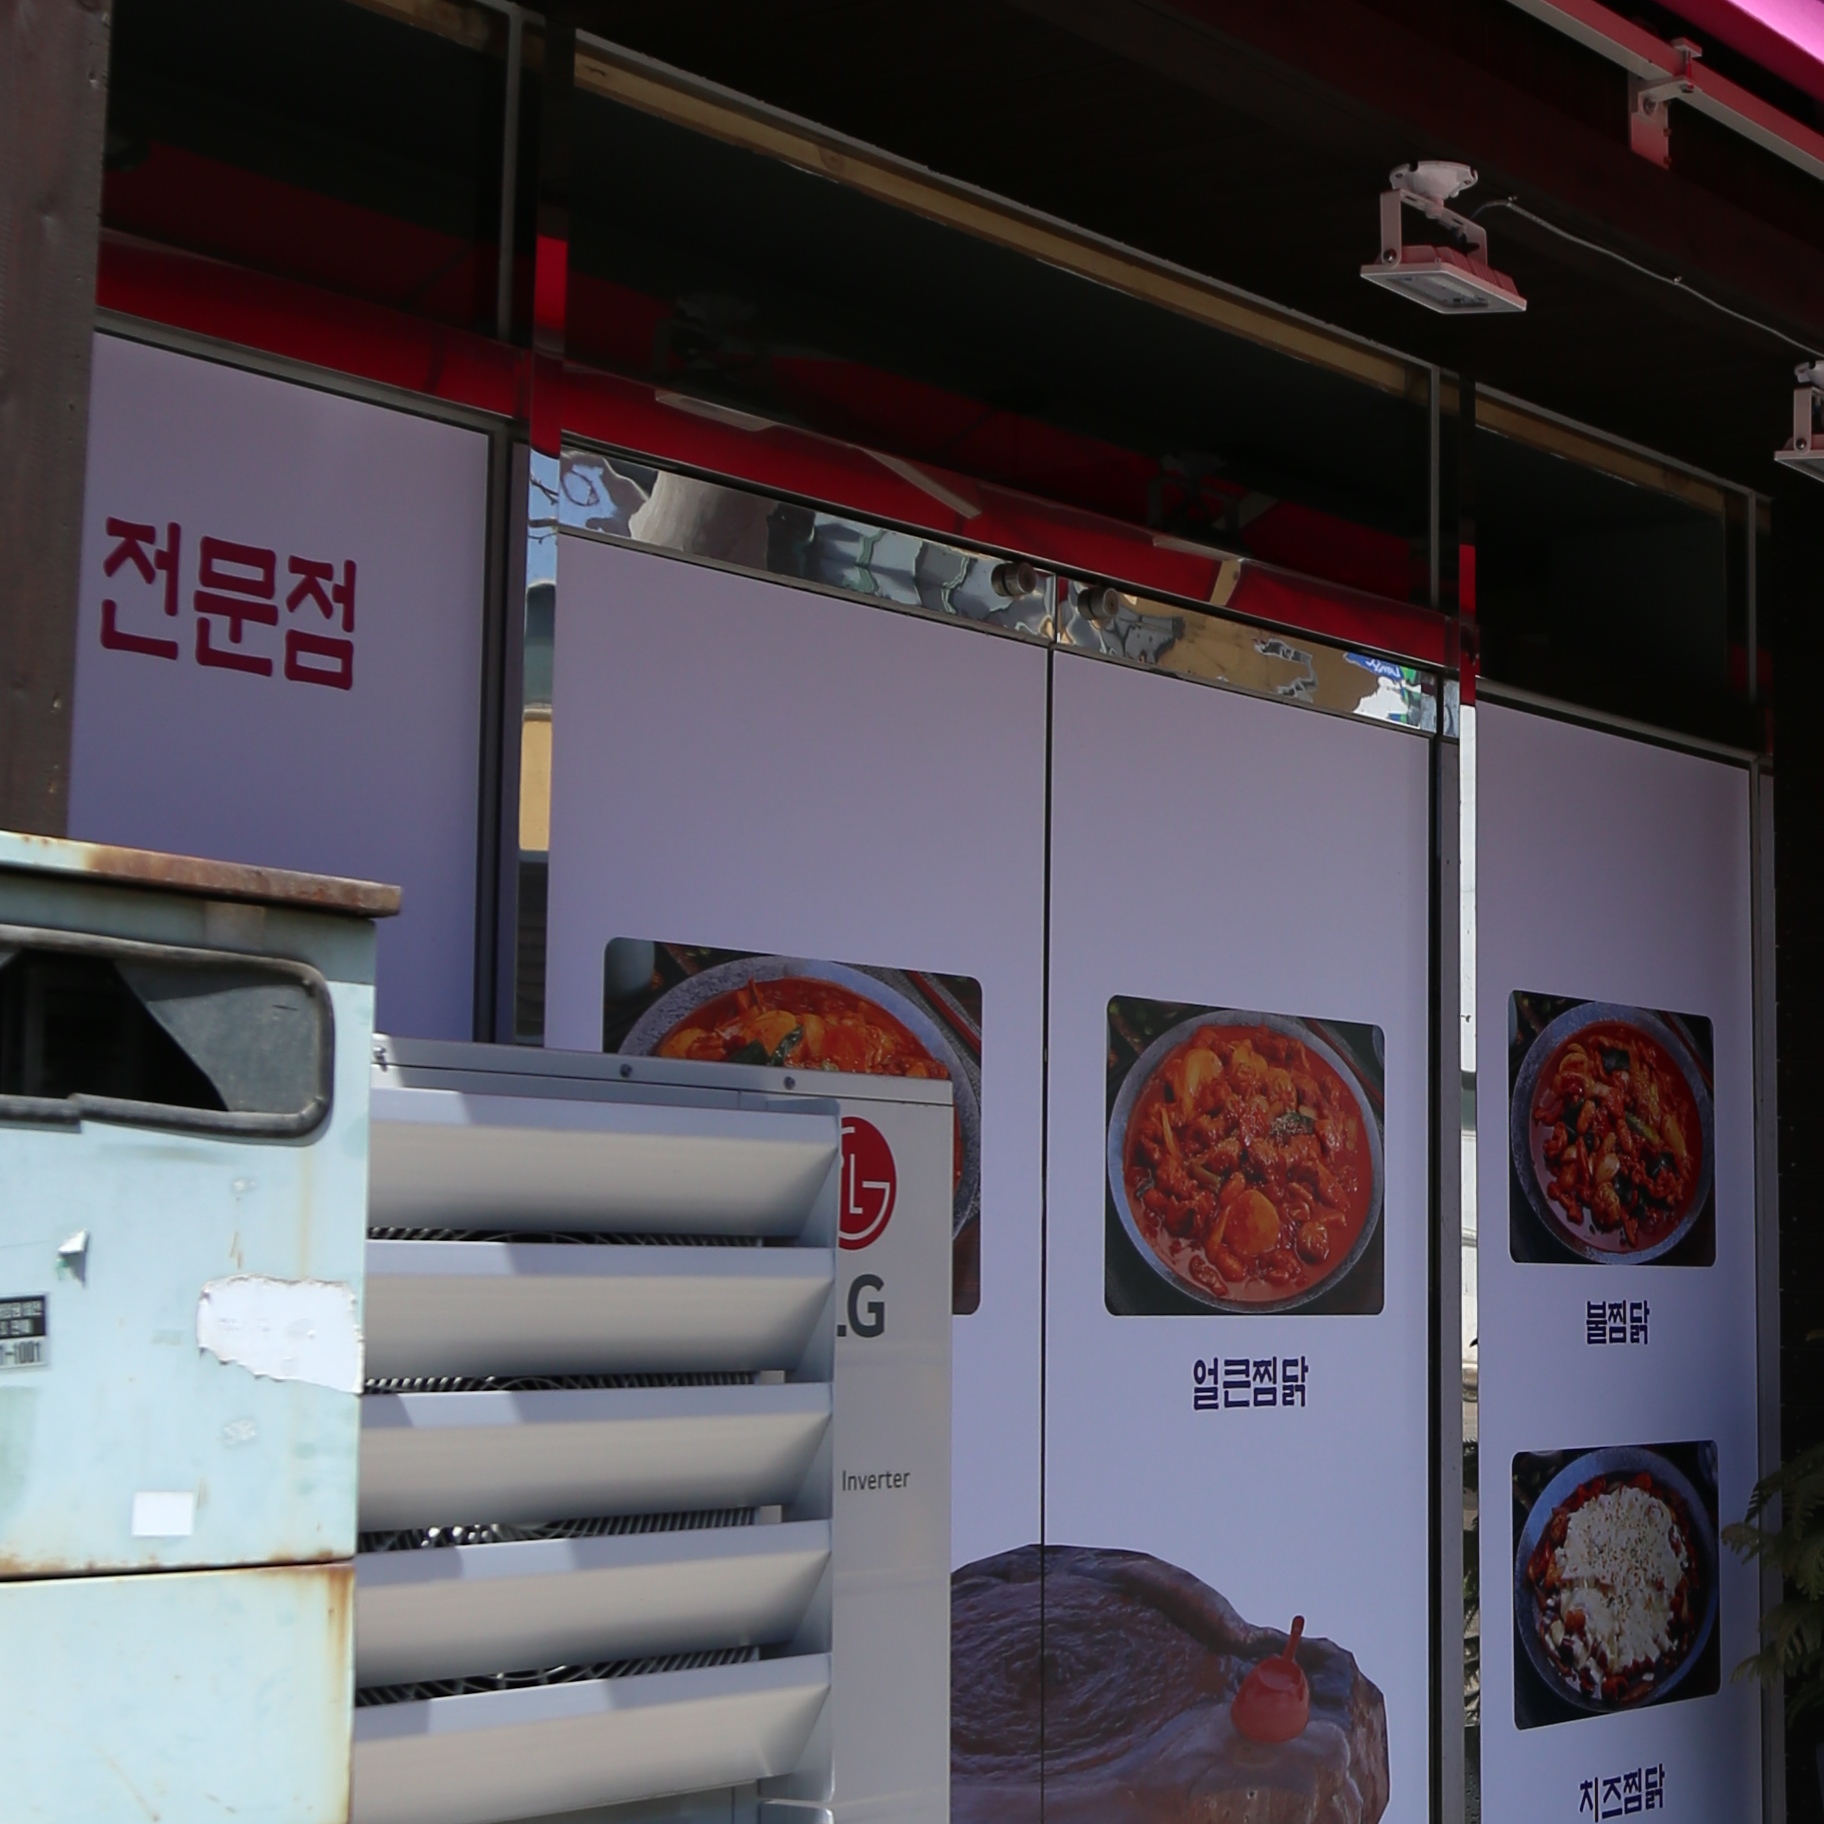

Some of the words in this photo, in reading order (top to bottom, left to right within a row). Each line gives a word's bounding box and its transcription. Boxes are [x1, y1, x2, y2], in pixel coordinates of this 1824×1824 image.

[99, 516, 358, 691] 전문점
[837, 1274, 885, 1338] G
[1584, 1299, 1651, 1346] 불찜닭
[1192, 1355, 1309, 1410] 얼큰찜닭
[842, 1470, 910, 1491] Inverter
[1578, 1763, 1666, 1824] 치즈찜닭
